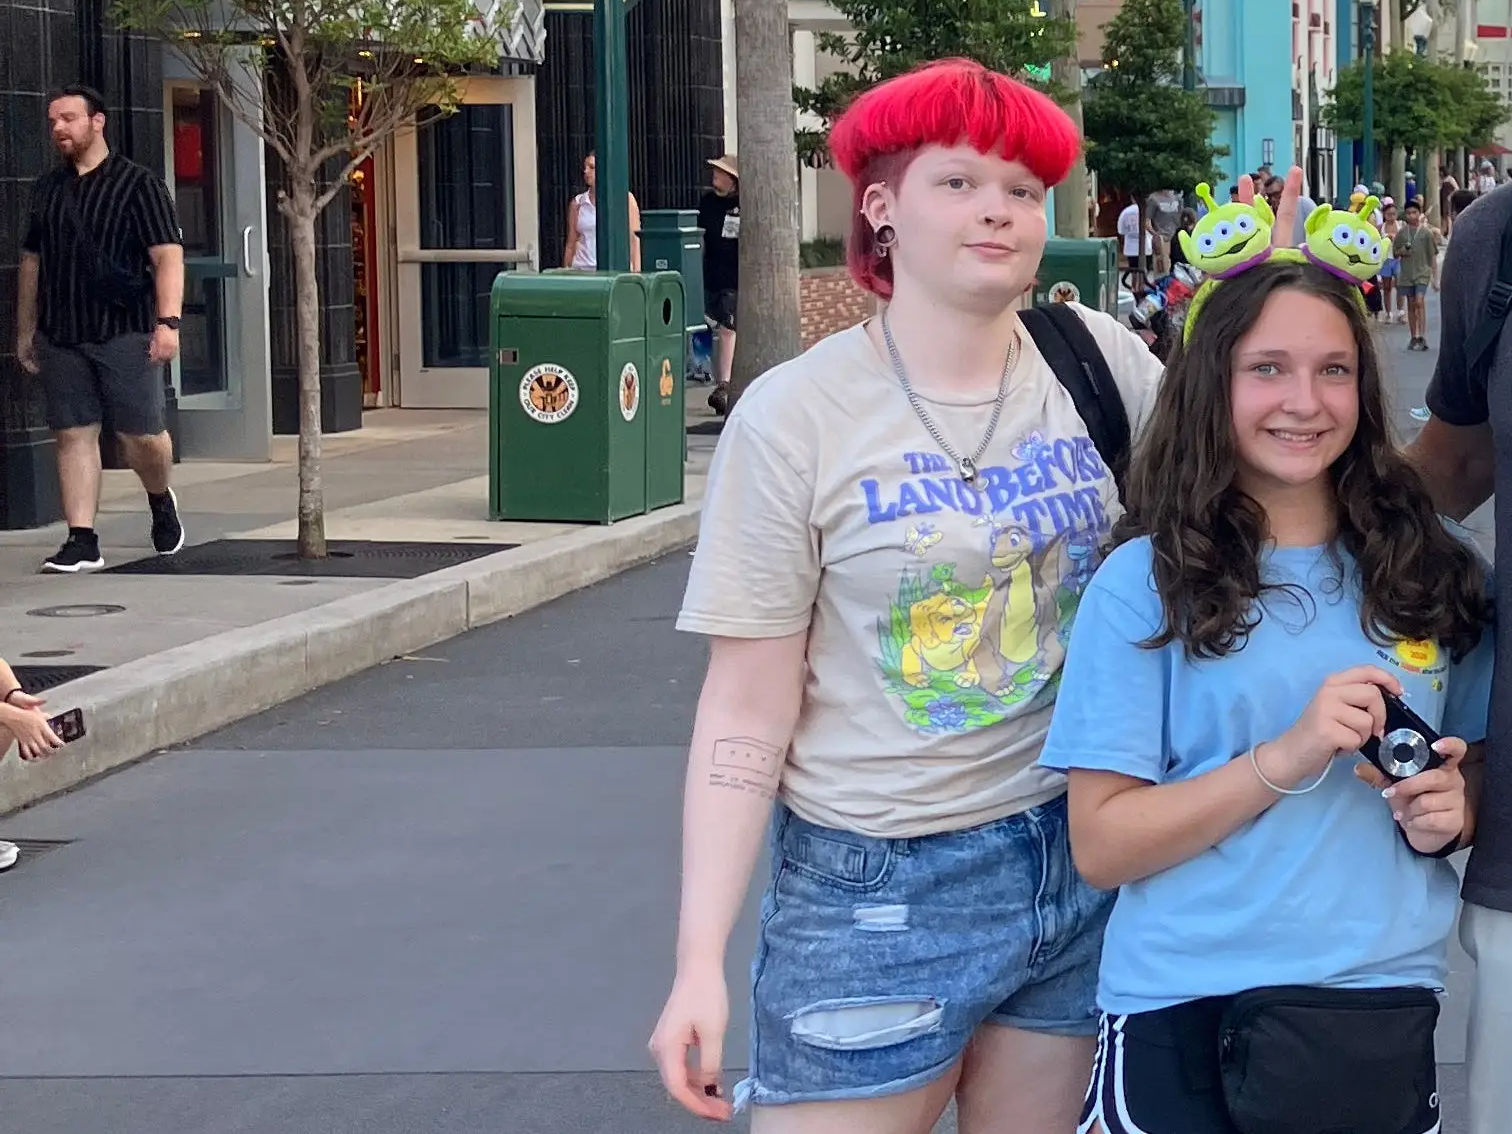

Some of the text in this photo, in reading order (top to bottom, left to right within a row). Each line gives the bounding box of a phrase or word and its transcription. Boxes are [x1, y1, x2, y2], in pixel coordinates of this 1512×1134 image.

[523, 368, 542, 390] PLEASE
[564, 374, 576, 391] KEEP
[523, 398, 575, 421] OUR CITY CLEAN
[860, 436, 1107, 525] LAND BEFOR
[1012, 486, 1111, 554] TIM
